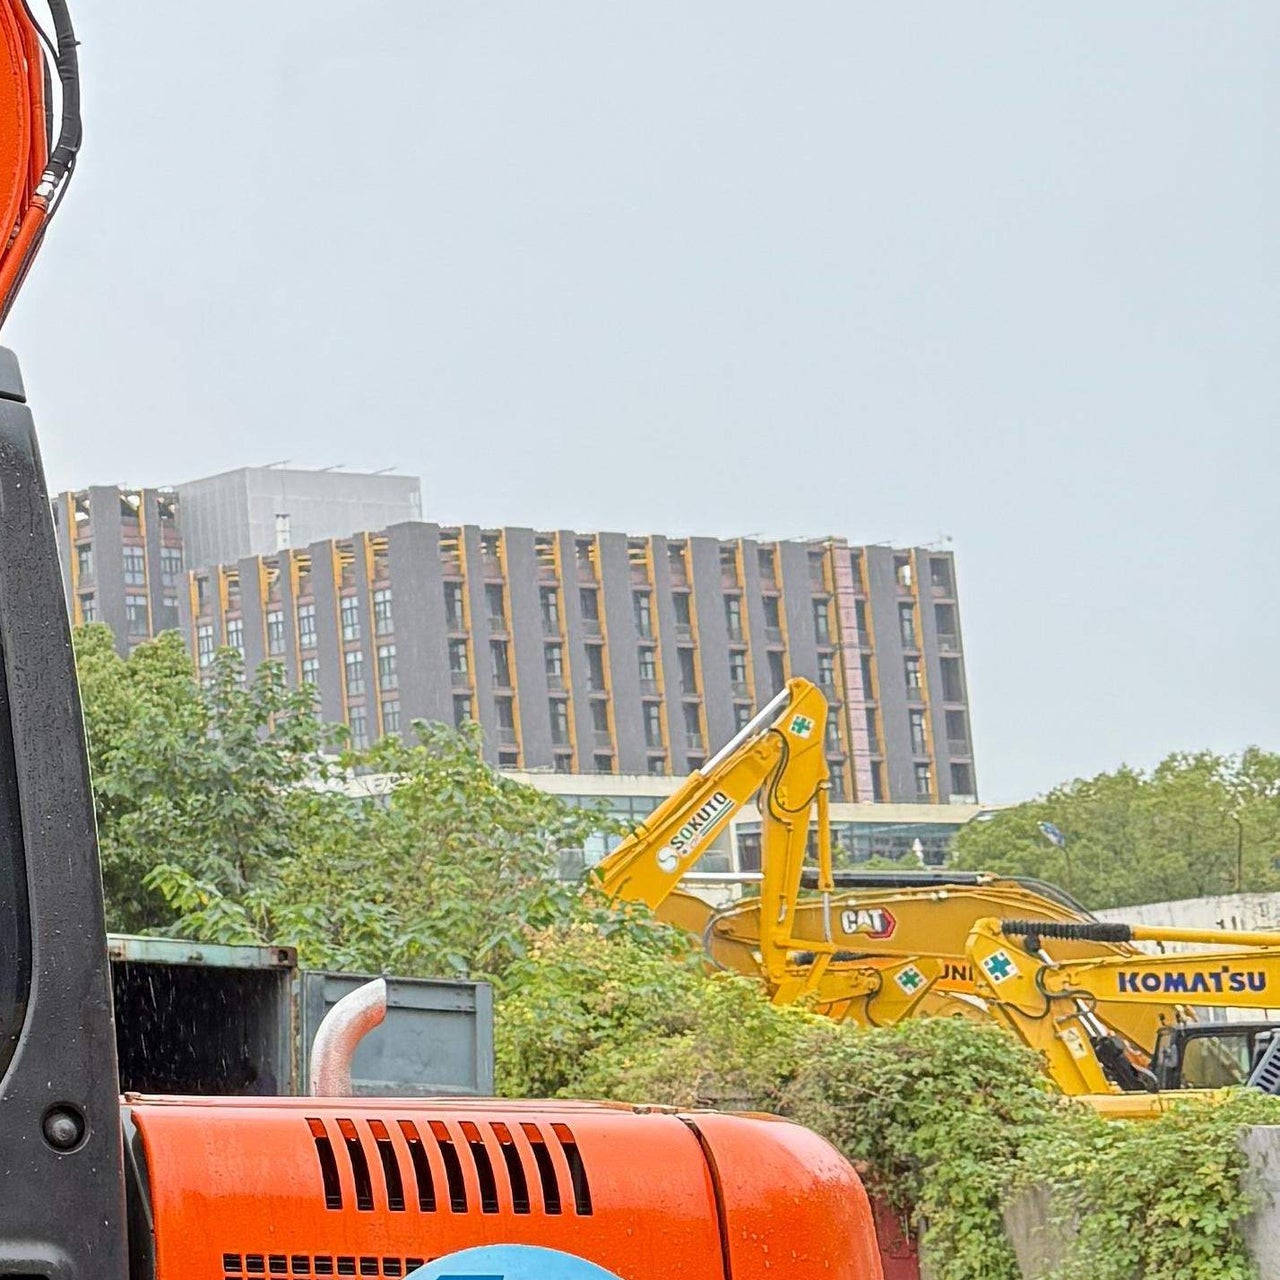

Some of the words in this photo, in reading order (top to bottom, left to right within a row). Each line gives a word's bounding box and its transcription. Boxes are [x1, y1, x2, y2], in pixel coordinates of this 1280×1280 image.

[670, 791, 728, 851] SOKUTO
[842, 909, 883, 934] CAT
[1118, 965, 1267, 993] KOMATSU
